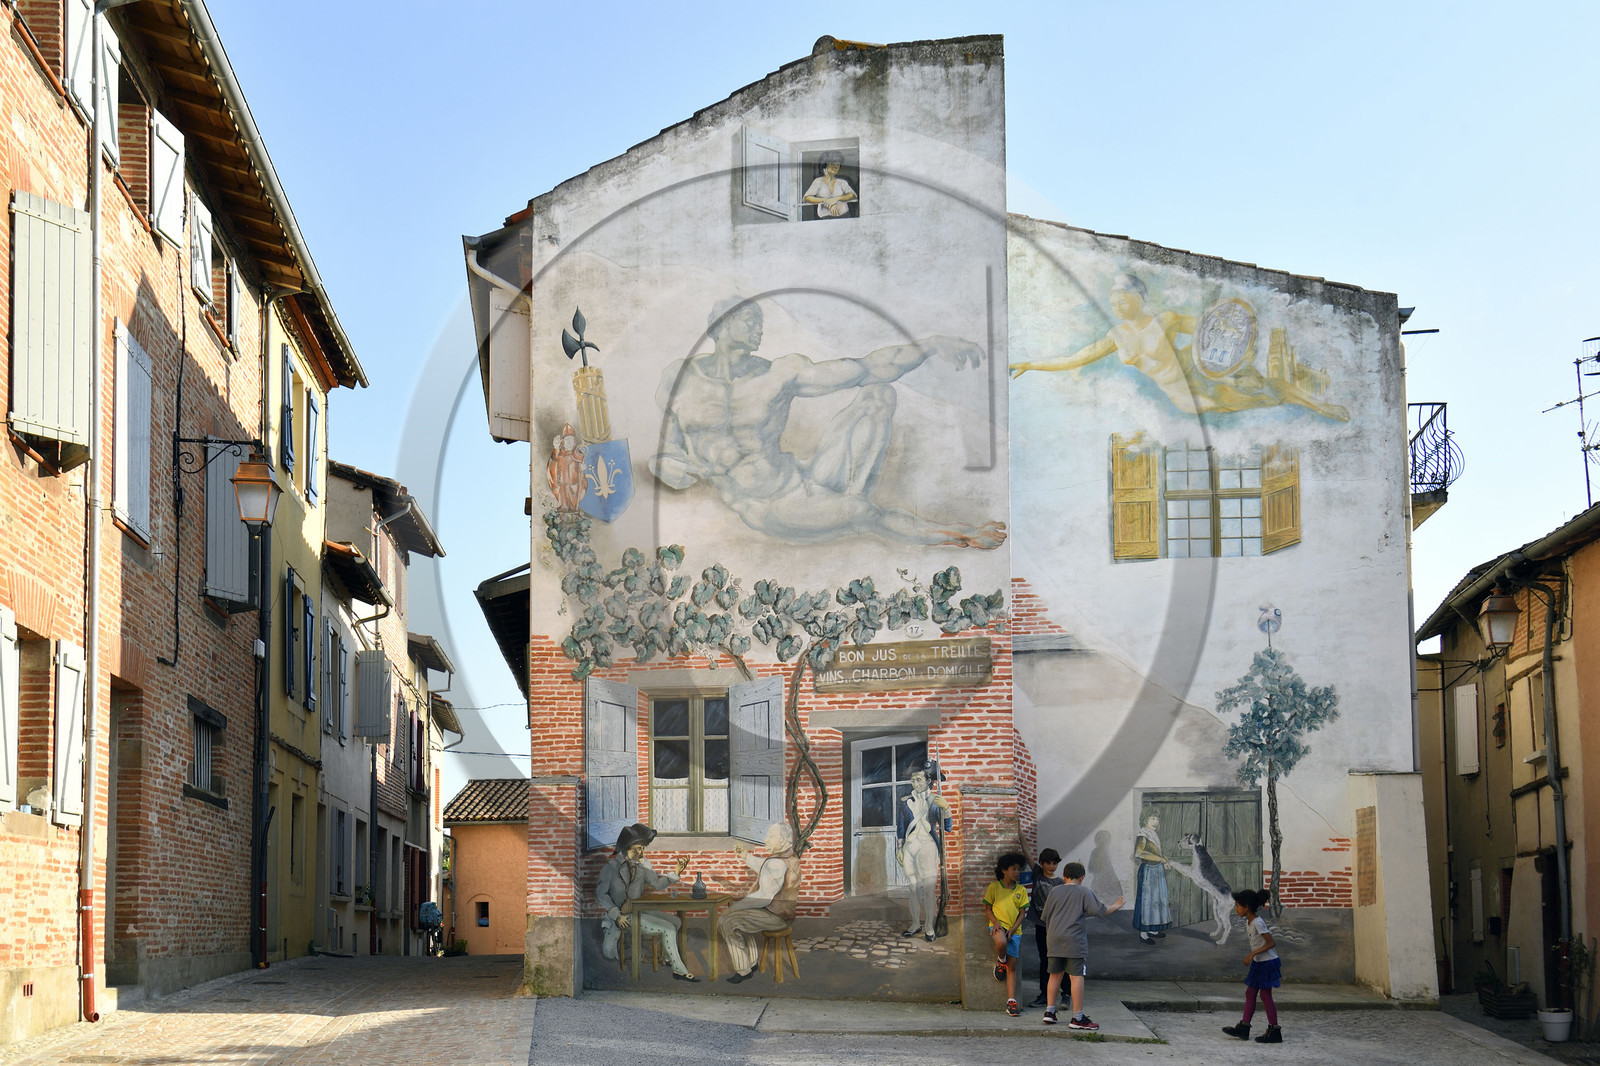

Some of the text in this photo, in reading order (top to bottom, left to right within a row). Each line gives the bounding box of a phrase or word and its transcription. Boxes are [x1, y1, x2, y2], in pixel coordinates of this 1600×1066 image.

[839, 650, 865, 663] BON
[872, 648, 897, 662] JUS
[930, 644, 982, 659] TREILLE
[819, 670, 844, 684] VINS
[852, 667, 916, 683] CHARBON
[927, 664, 984, 680] DOMICILE
